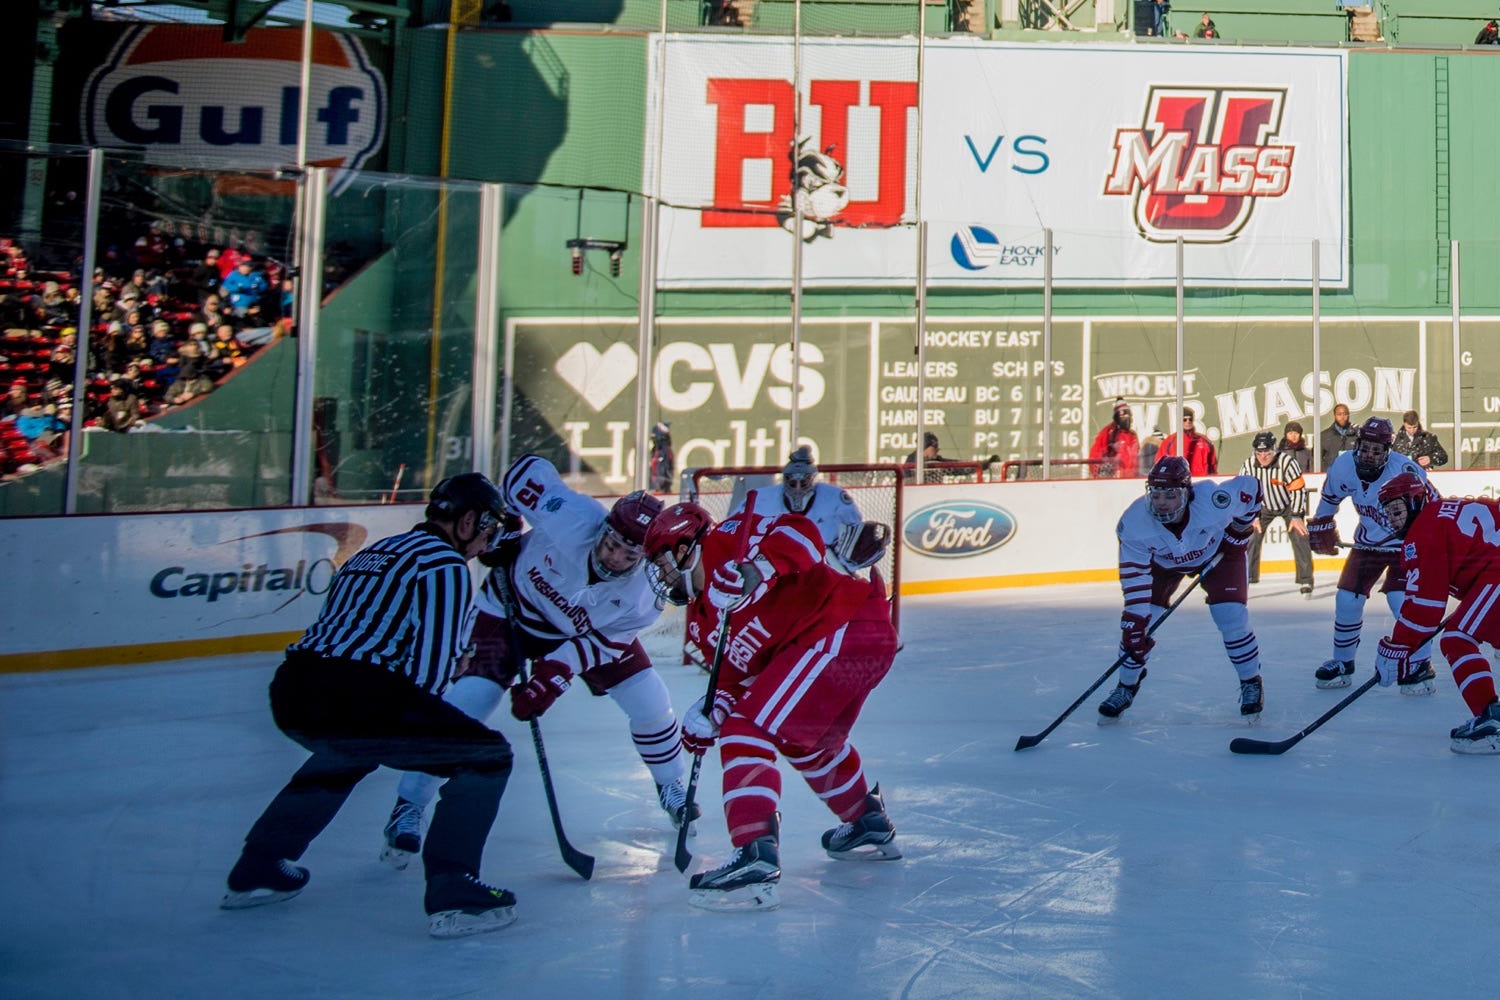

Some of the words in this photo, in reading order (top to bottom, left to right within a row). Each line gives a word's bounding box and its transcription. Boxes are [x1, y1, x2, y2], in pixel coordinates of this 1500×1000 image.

[106, 75, 364, 146] Gulf
[700, 78, 920, 229] BU
[964, 135, 1050, 174] VS
[1000, 255, 1036, 266] EAST
[925, 331, 992, 347] HOCKEY
[996, 331, 1041, 347] EAST
[1461, 351, 1472, 365] G
[653, 341, 826, 411] CVS
[993, 361, 1027, 377] SCH
[976, 386, 999, 402] BC
[1011, 385, 1023, 400] 6
[1061, 384, 1082, 400] 22
[1097, 376, 1149, 397] WHO
[1214, 366, 1416, 439] MASON
[975, 408, 999, 425] BU
[1011, 407, 1022, 424] 7
[1060, 407, 1082, 424] 20
[974, 431, 998, 447] PC
[1010, 430, 1022, 448] 7
[1062, 430, 1080, 446] 16
[1461, 437, 1480, 452] AT
[516, 478, 545, 511] 15
[921, 509, 995, 550] Ford
[150, 558, 336, 602] CapitalO
